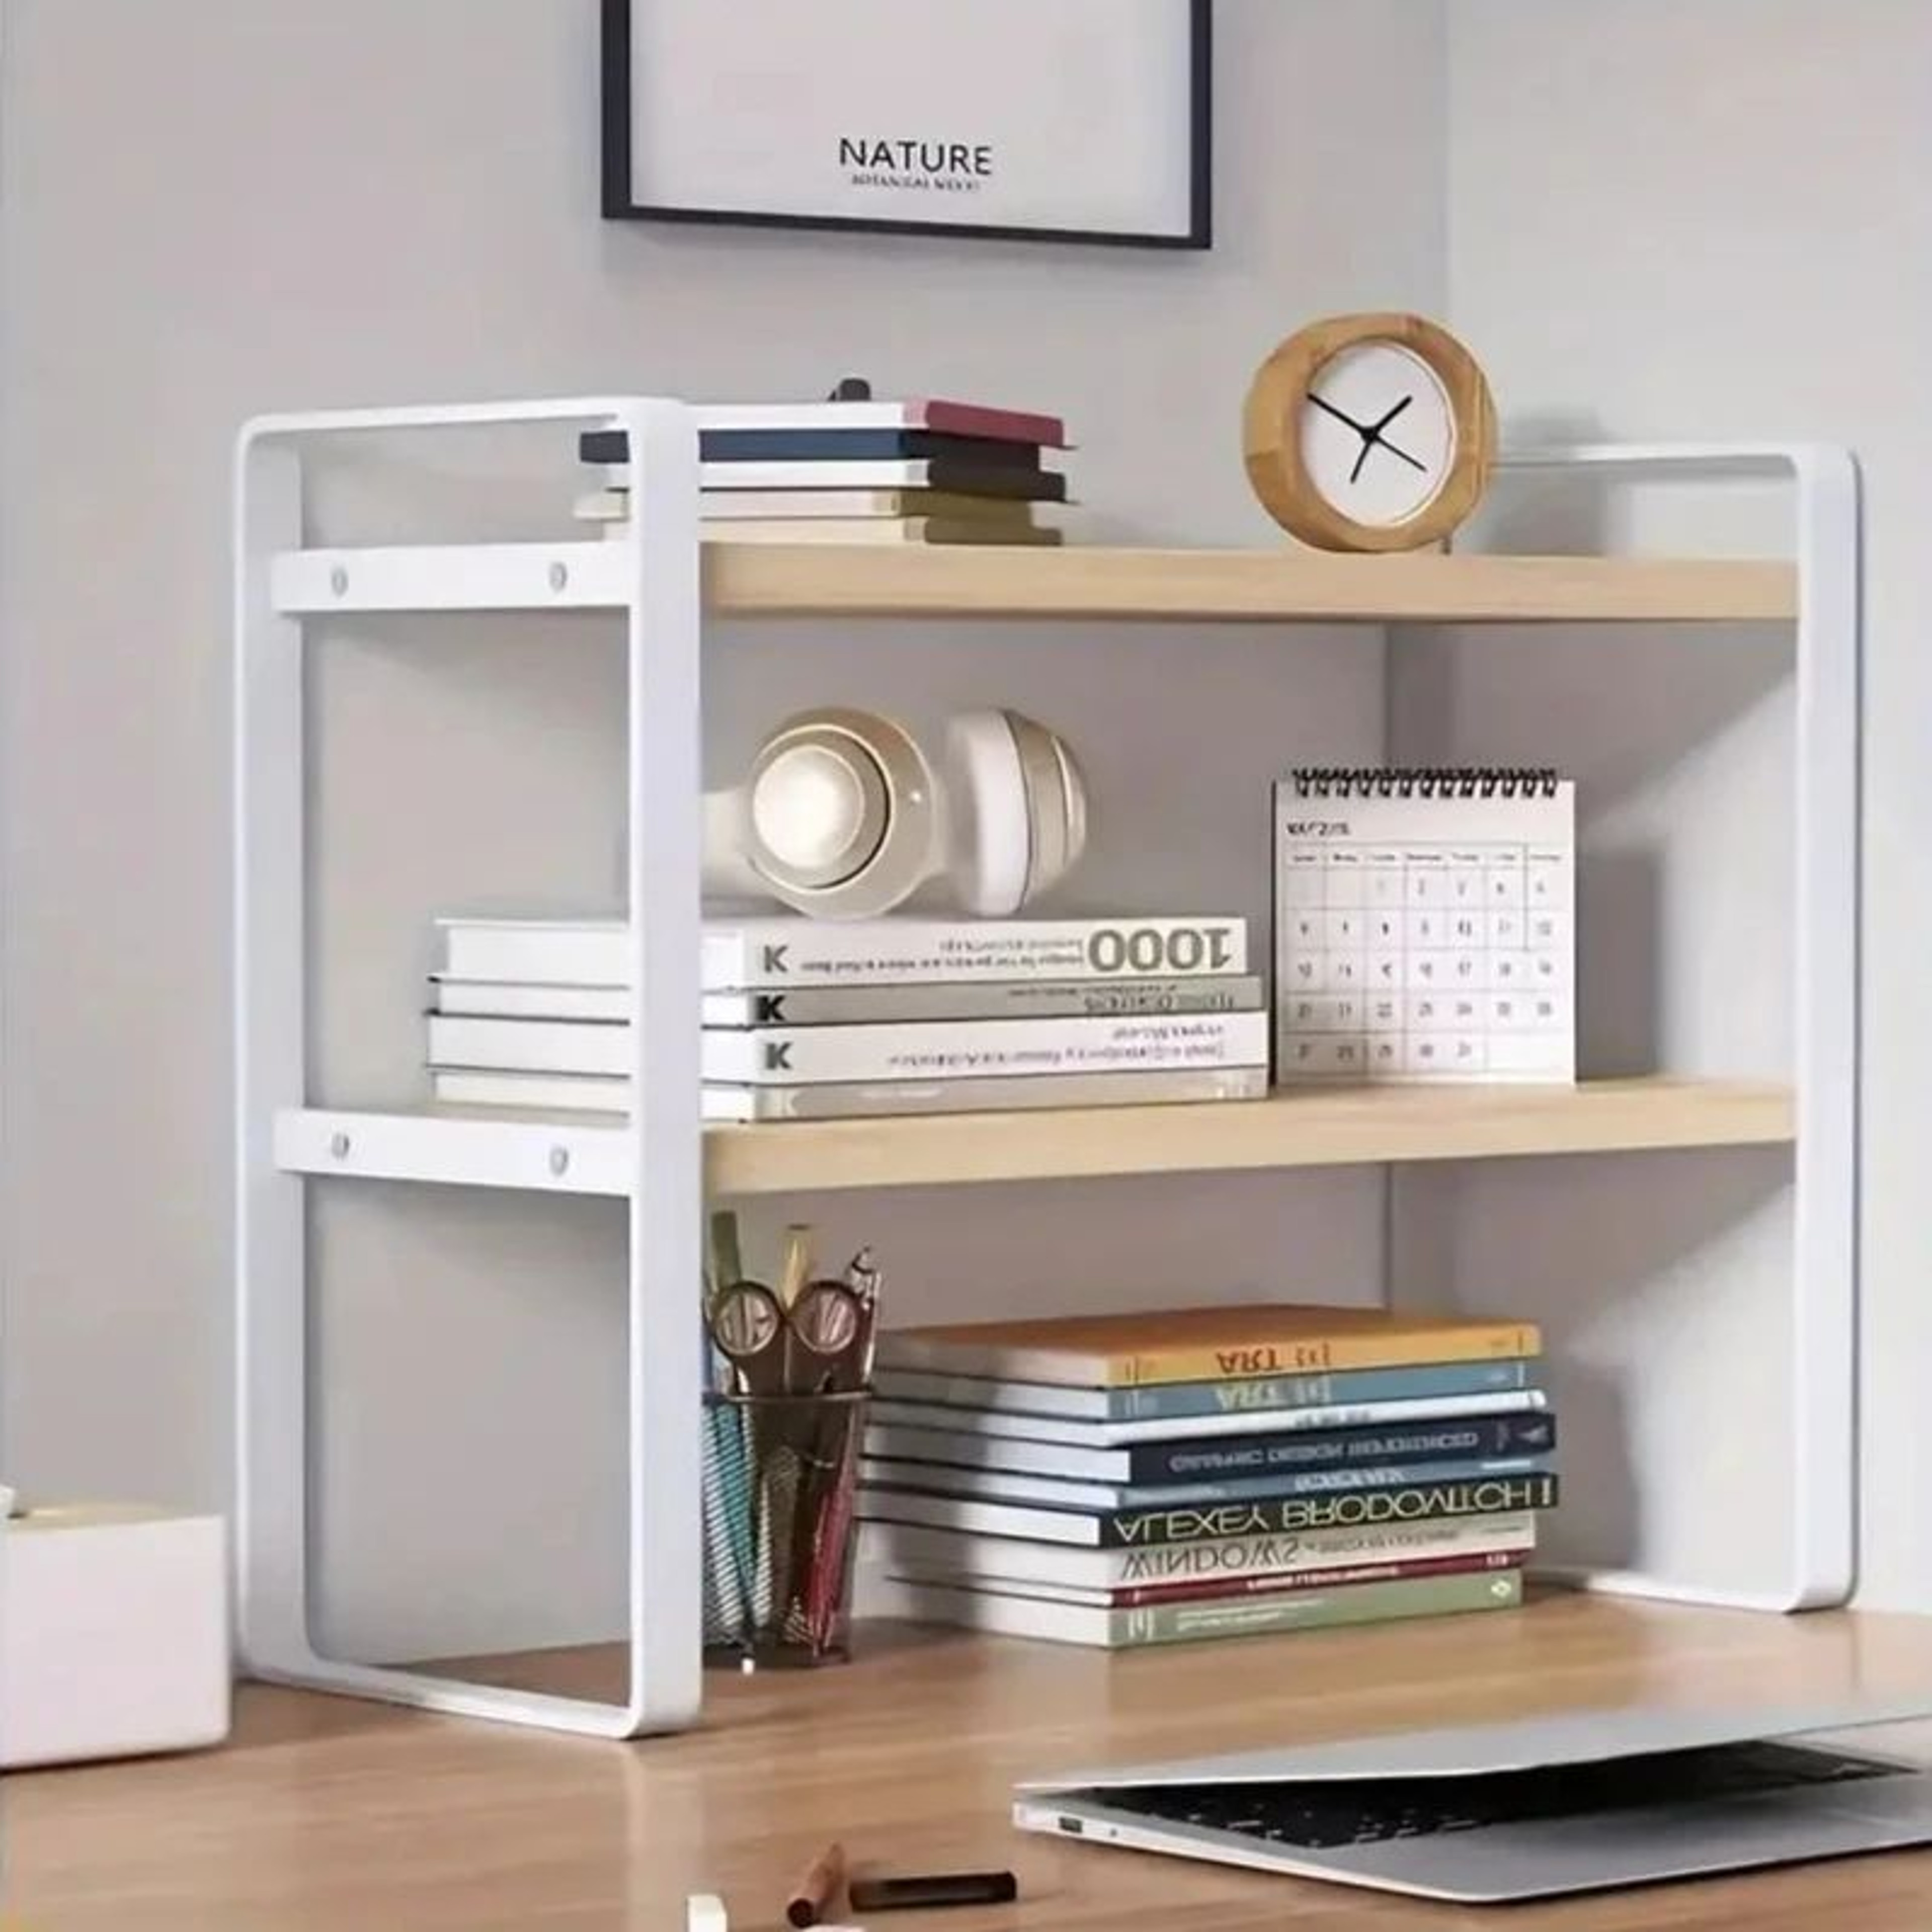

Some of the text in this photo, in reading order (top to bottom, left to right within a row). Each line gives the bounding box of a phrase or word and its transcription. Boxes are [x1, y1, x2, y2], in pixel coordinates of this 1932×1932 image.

[839, 138, 992, 175] NATURE
[763, 945, 788, 973] K
[1088, 928, 1232, 973] 1000
[760, 994, 785, 1022] K
[765, 1042, 791, 1070] K
